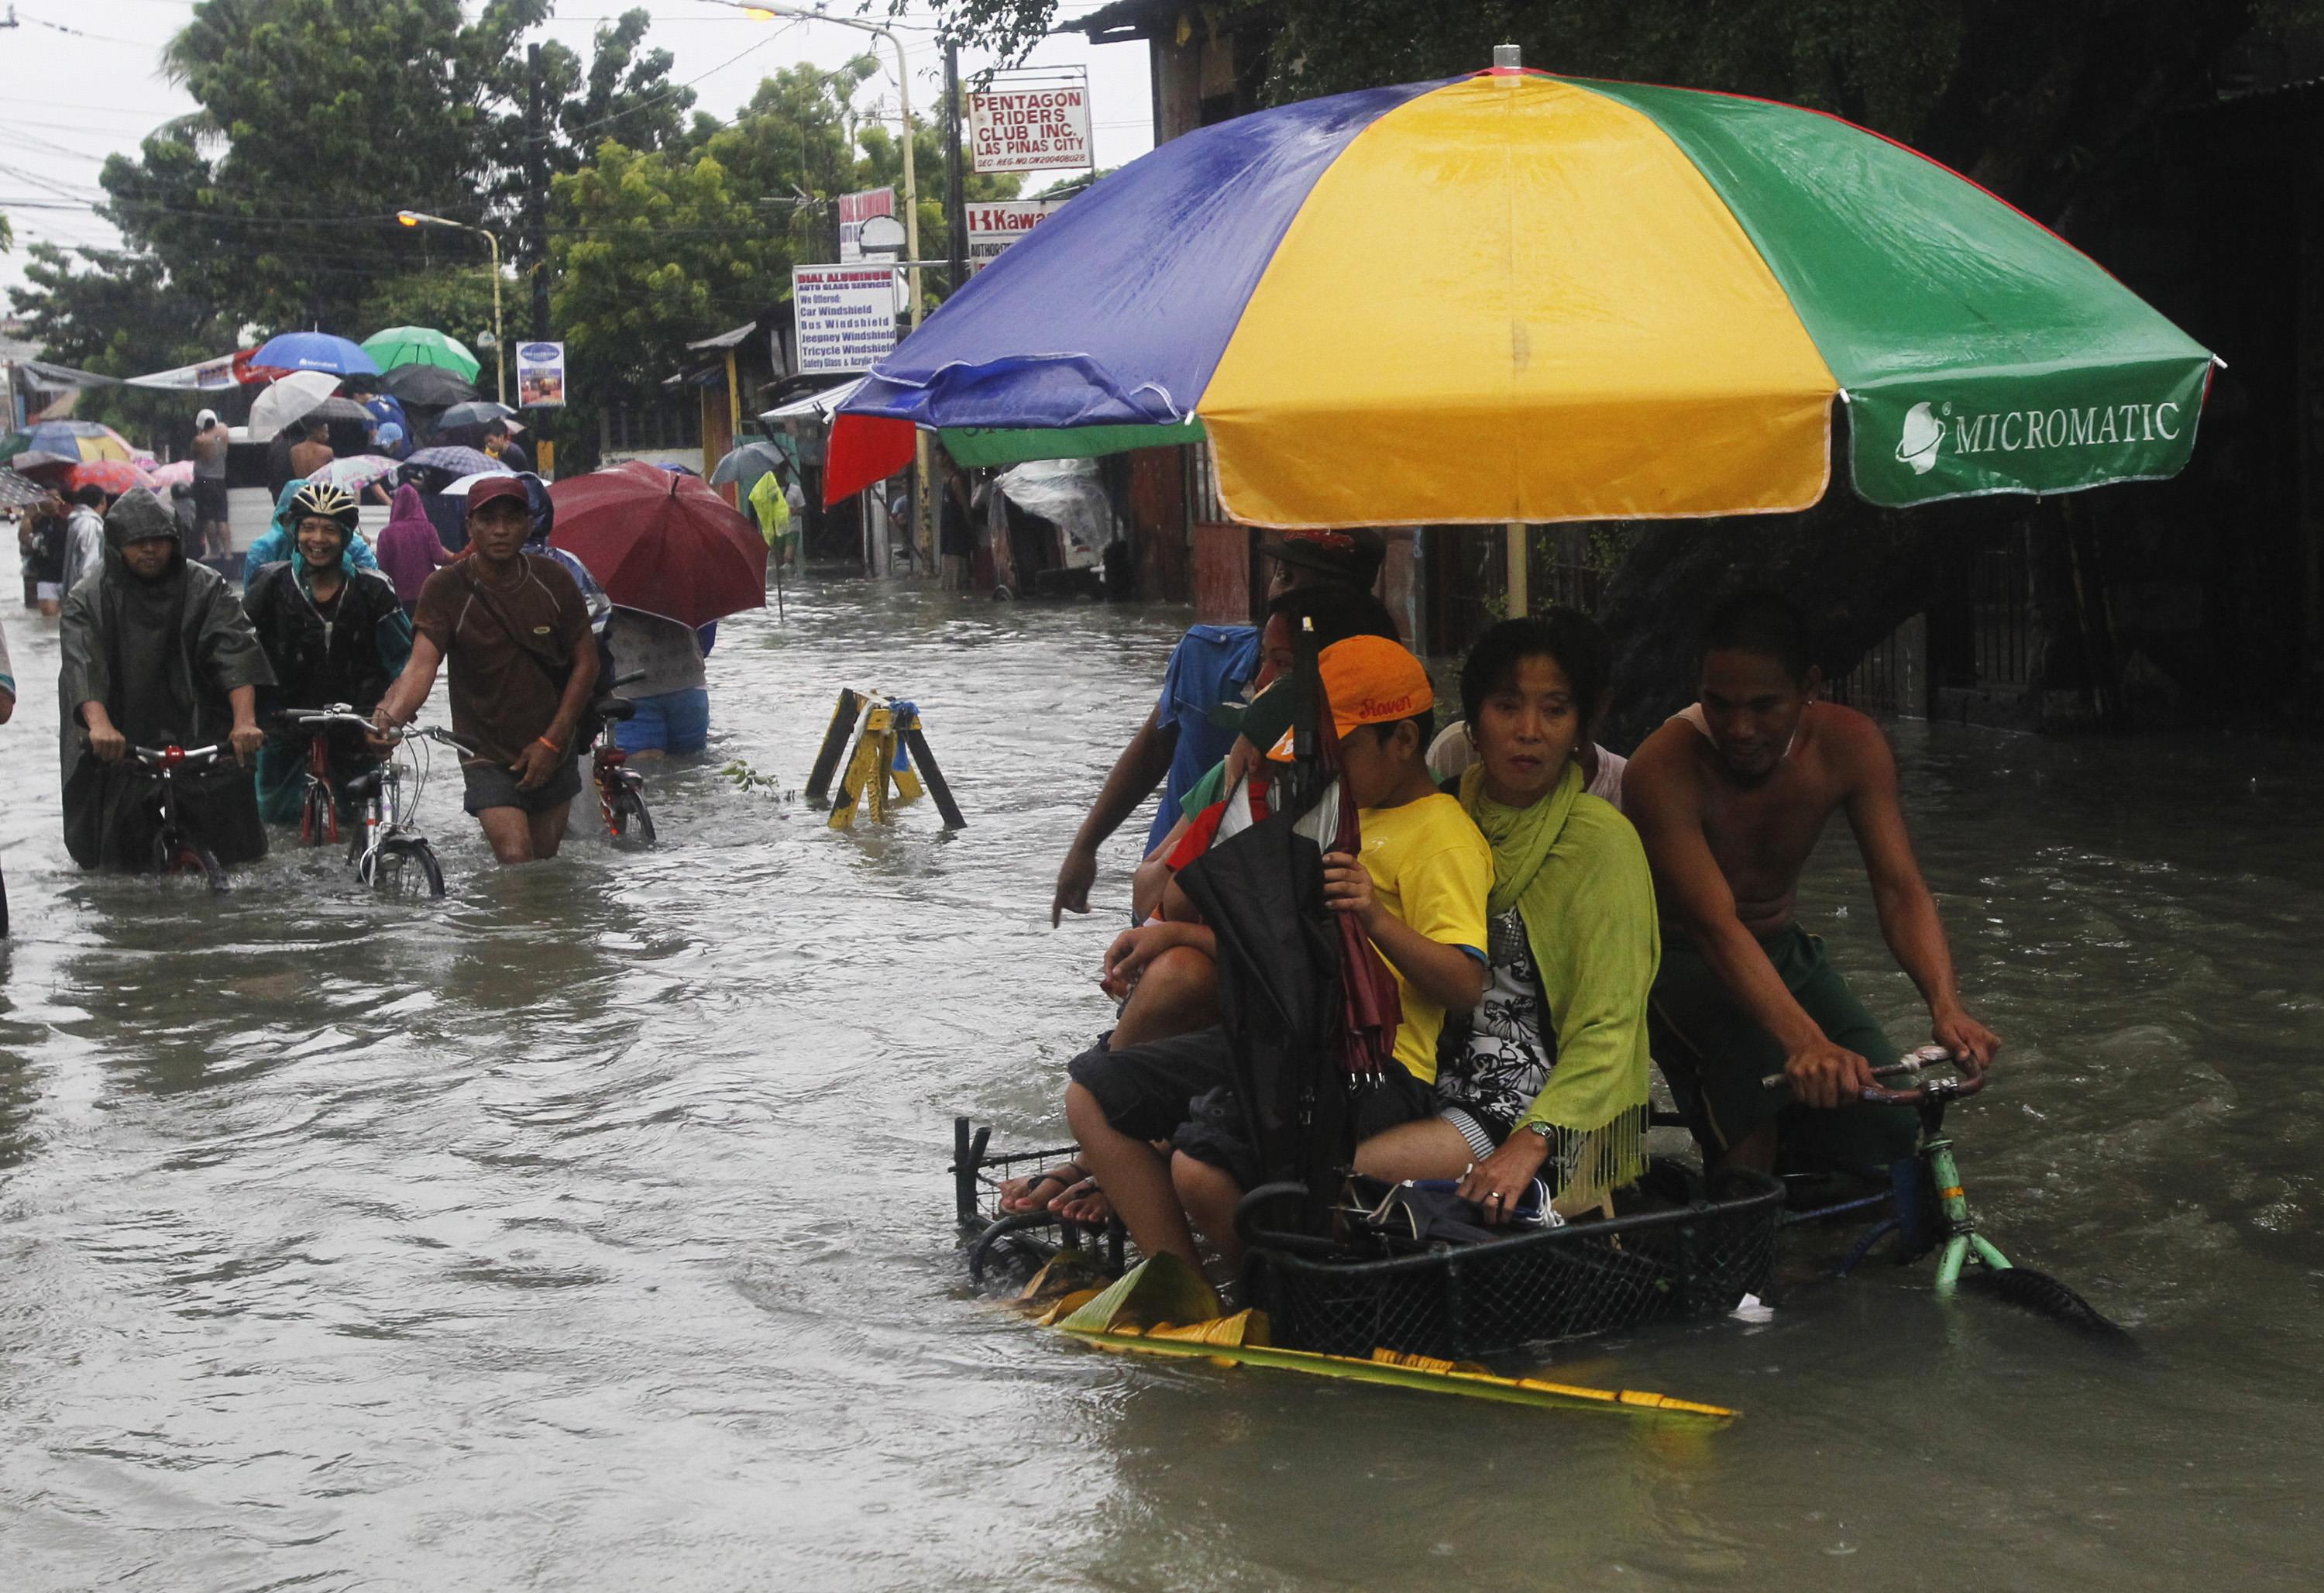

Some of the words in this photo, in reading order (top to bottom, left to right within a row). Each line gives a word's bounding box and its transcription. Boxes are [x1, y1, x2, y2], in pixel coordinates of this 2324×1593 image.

[974, 92, 1081, 112] PENTAGON
[992, 108, 1066, 126] RIDERS
[978, 126, 1029, 142] CLUB
[1040, 123, 1077, 139] INC.
[977, 142, 1001, 156] LAS
[1007, 139, 1049, 154] PINAS
[1054, 137, 1084, 151] CITY
[798, 274, 824, 284] DIAL
[827, 270, 892, 282] ALUMINUM
[799, 295, 812, 304] We
[800, 307, 816, 317] Car
[818, 304, 872, 316] Windshield
[801, 321, 821, 330] Bus
[825, 317, 889, 329] Windshield
[802, 333, 840, 342] Jeepney
[841, 330, 896, 342] Windshield
[803, 346, 841, 356] Tricycle
[803, 358, 823, 368] Safety
[823, 358, 841, 366] Glass
[844, 358, 848, 366] &
[1954, 401, 2181, 454] MICROMATIC
